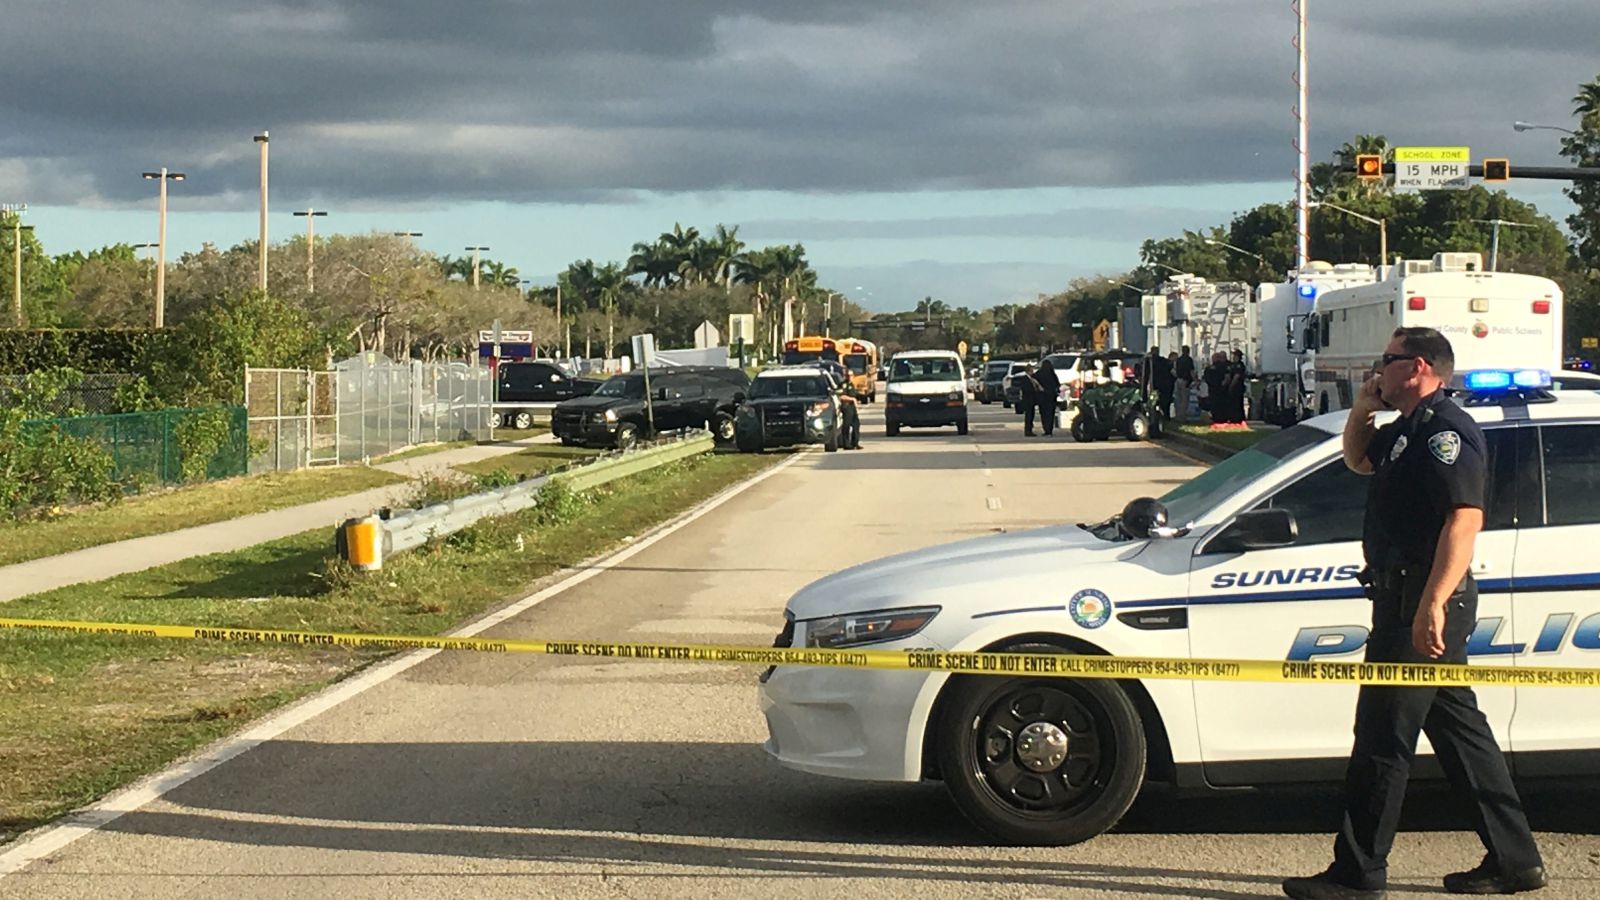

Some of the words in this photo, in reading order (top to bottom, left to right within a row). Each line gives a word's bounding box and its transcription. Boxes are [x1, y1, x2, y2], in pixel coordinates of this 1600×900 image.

[1403, 151, 1434, 159] SCHOOL
[1407, 165, 1420, 176] 15
[1431, 165, 1459, 176] MPH
[1428, 179, 1466, 187] FLASHING
[1492, 326, 1513, 335] Public
[1211, 564, 1360, 589] SUNRIS
[546, 642, 579, 655] CRIME
[582, 643, 615, 657] SCENE
[617, 645, 632, 658] DO
[635, 646, 655, 659] NOT
[658, 646, 691, 660] ENTER
[694, 648, 713, 661] CALL
[715, 649, 783, 664] CRIMESTOPPERS
[908, 653, 942, 669] CRIME
[945, 654, 979, 671] SCENE
[982, 655, 997, 671] DO
[1000, 656, 1021, 672] NOT
[1024, 657, 1057, 673] ENTER
[1060, 658, 1081, 673] CALL
[1084, 658, 1153, 675] CRIMESTOPPERS
[1154, 661, 1209, 676] 954-493-TIPS
[1211, 662, 1240, 677] (8477)
[1282, 662, 1317, 679] CRIME
[1320, 663, 1355, 680] SCENE
[1358, 664, 1374, 681] DO
[1377, 665, 1398, 682] NOT
[1401, 665, 1436, 682] ENTER
[1439, 667, 1461, 682] CALL
[1463, 668, 1535, 684] CRIMESTOPPERS
[1537, 671, 1594, 685] 954-493-TIPS
